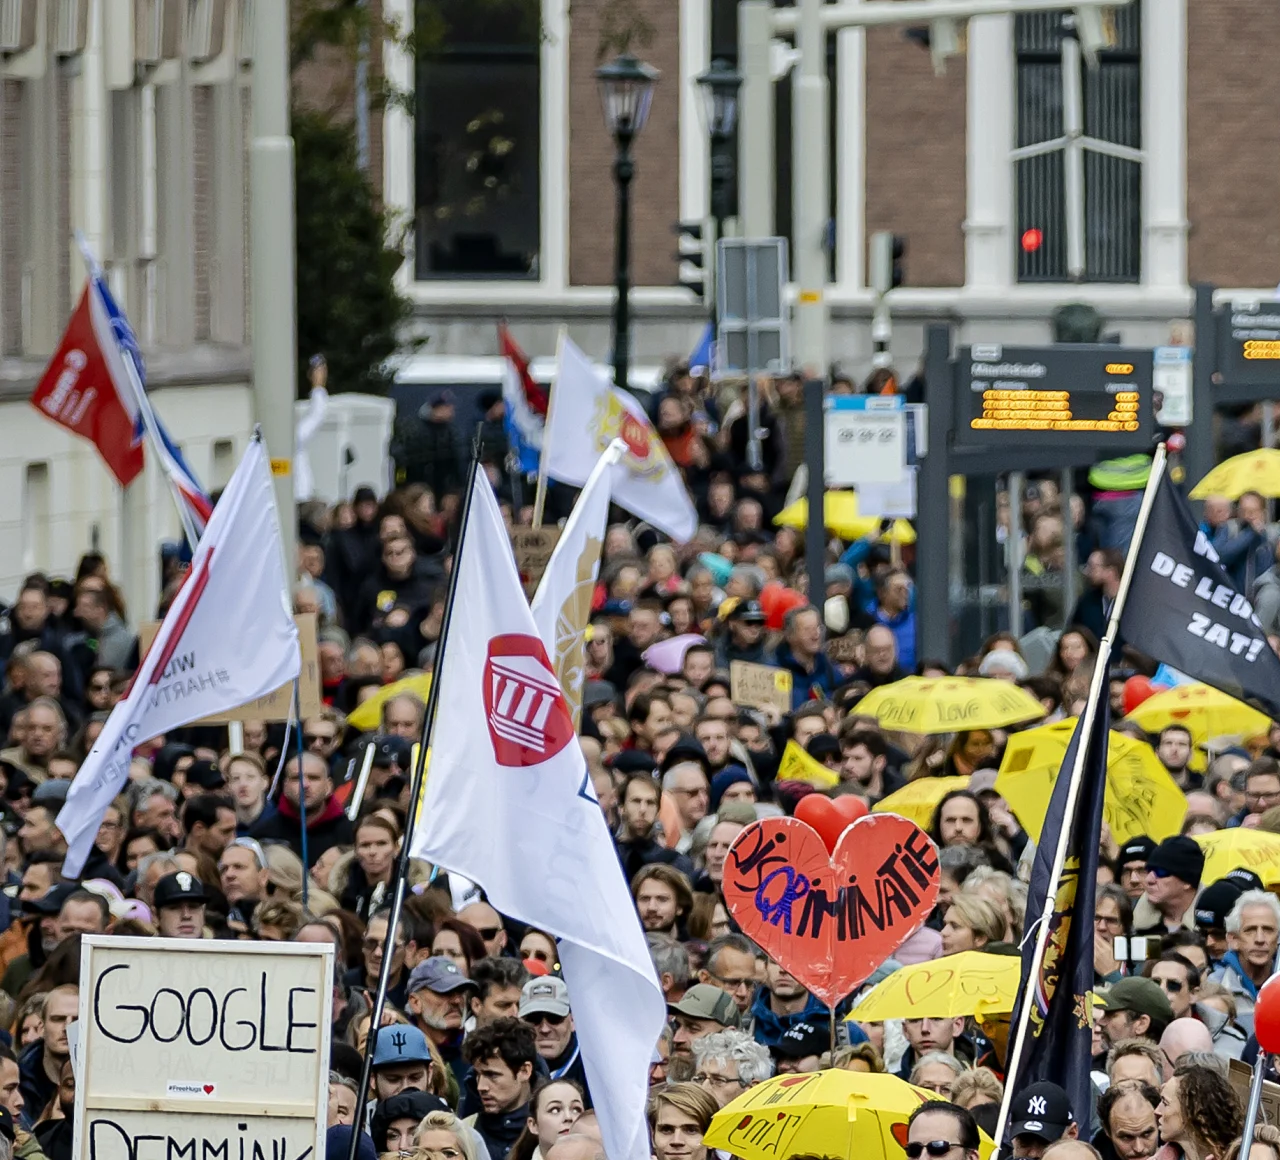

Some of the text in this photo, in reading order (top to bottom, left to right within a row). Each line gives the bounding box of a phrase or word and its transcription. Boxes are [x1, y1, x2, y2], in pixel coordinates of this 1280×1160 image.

[1150, 551, 1195, 588] DE
[1186, 611, 1265, 662] ZAT!
[94, 963, 317, 1053] GOOGLE
[168, 1084, 202, 1093] #FreeHugs
